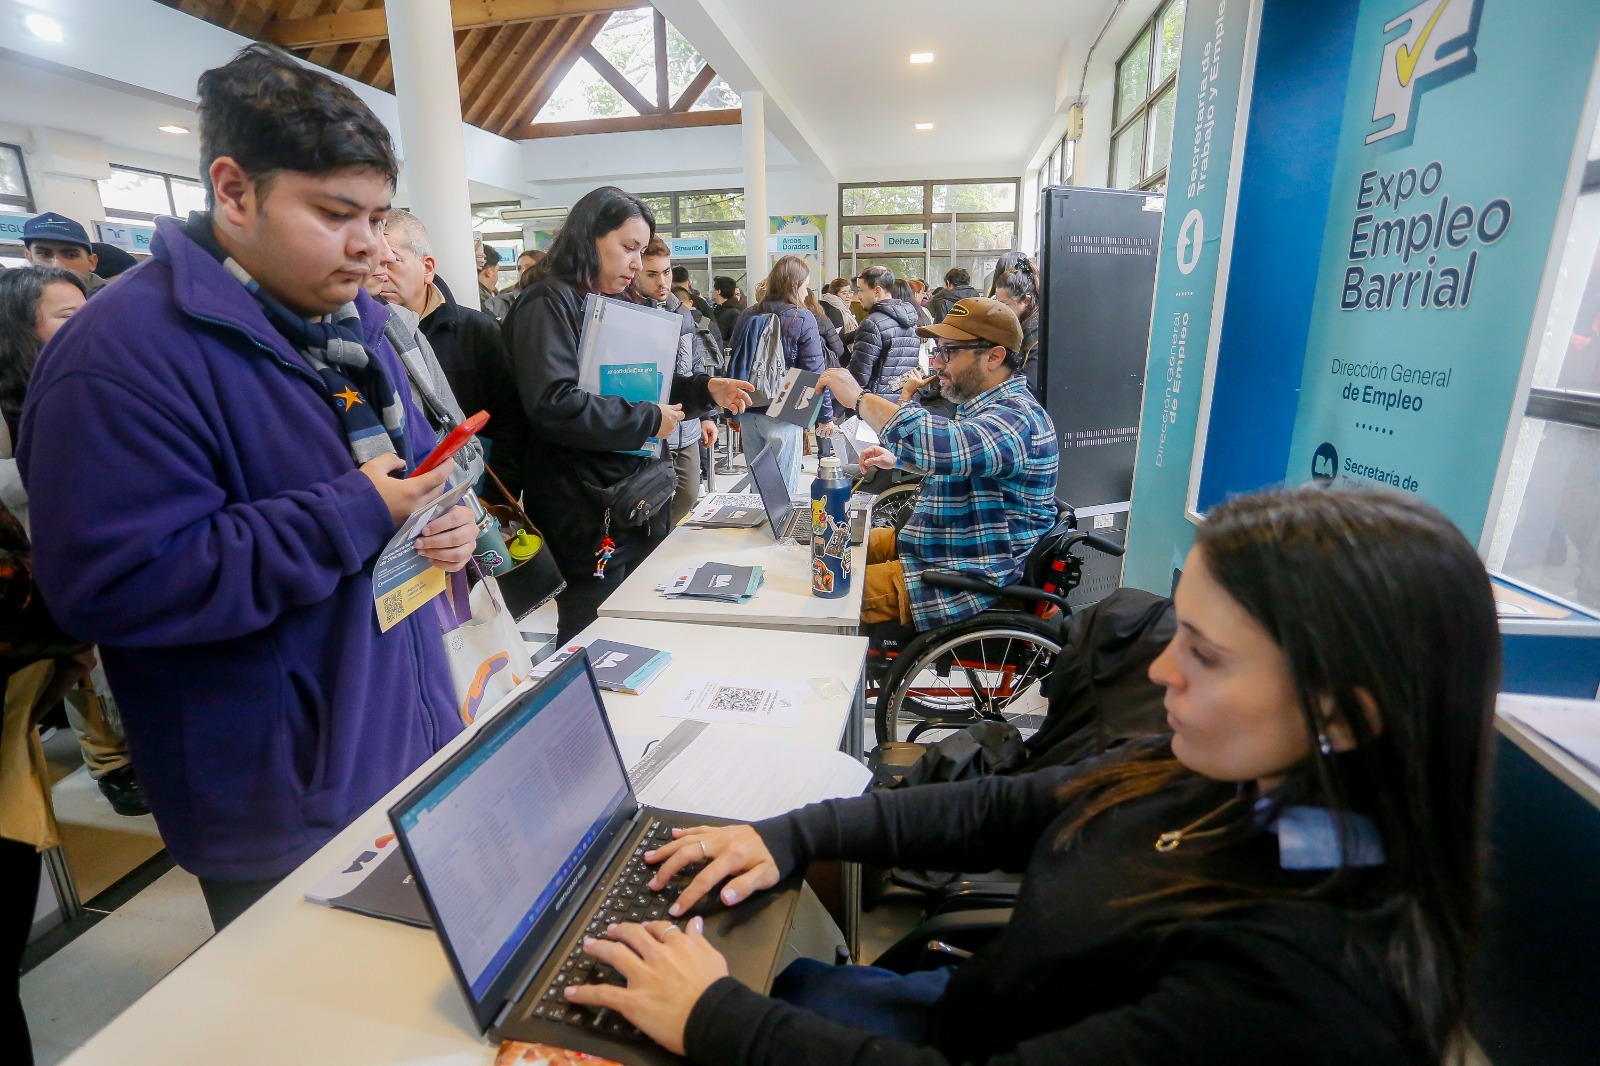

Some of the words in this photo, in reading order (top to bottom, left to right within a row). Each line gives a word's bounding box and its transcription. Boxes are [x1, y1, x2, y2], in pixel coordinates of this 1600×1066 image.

[1187, 76, 1208, 198] Secretaría
[1202, 42, 1212, 73] de
[1197, 104, 1215, 195] Trabajo
[1208, 87, 1218, 101] y
[1357, 161, 1443, 211] Expo
[1348, 195, 1512, 265] Empleo
[1340, 250, 1478, 311] Barrial
[1166, 312, 1180, 382] General
[1173, 312, 1189, 393] Empleo
[1331, 358, 1387, 380] Dirección
[1390, 363, 1452, 387] General
[1170, 399, 1178, 423] de
[1342, 382, 1359, 400] de
[1362, 385, 1423, 411] Empleo
[1344, 457, 1400, 487] Secretaría
[1402, 475, 1418, 492] de
